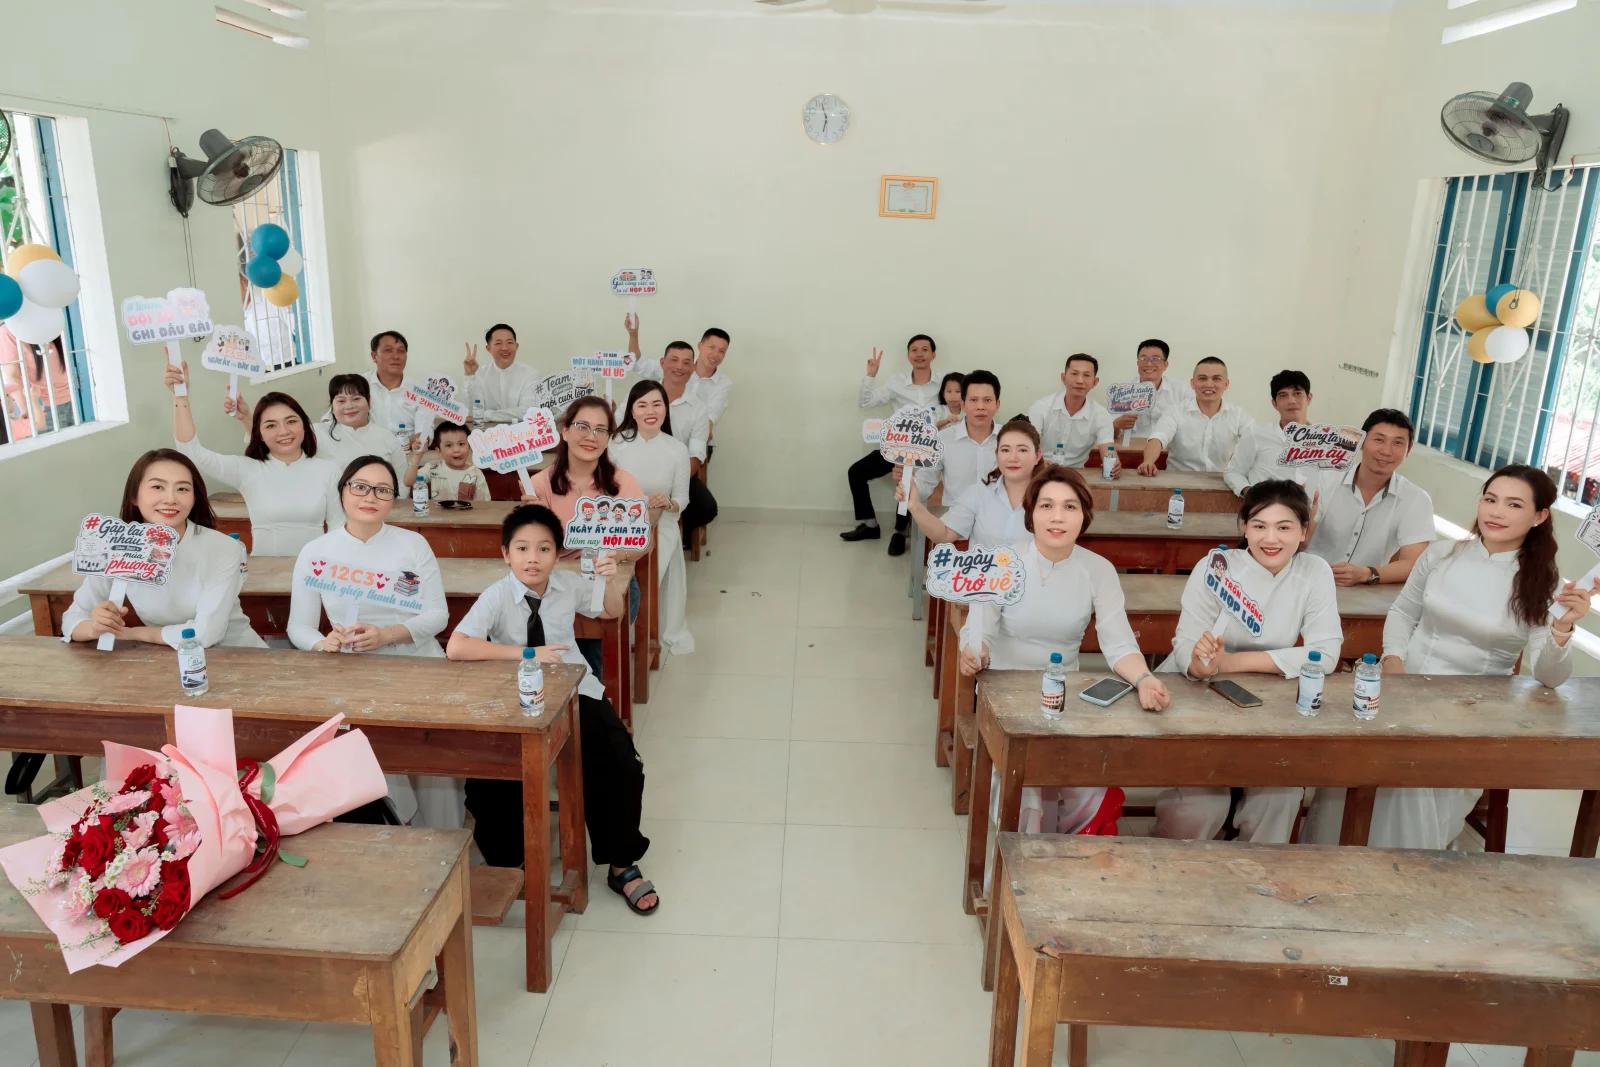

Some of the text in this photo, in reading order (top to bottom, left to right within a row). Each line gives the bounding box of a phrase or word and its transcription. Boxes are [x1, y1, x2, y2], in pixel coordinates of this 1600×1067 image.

[127, 311, 153, 328] ĐỘI
[132, 320, 211, 341] GHI ĐẦU BÀI
[572, 358, 623, 367] MỘT HÀNH TRÌNH
[613, 367, 625, 377] ỨC
[558, 391, 574, 405] cuối
[574, 388, 586, 399] lớp
[404, 390, 463, 423] NK 2003-2006
[896, 419, 924, 435] Hội
[886, 429, 910, 443] bạn
[911, 432, 940, 452] thân
[1302, 439, 1317, 447] của
[1327, 432, 1338, 443] ta
[479, 434, 555, 465] Nơi Thanh Xuân
[1325, 446, 1348, 465] ấy
[499, 450, 539, 471] còn mãi
[127, 524, 146, 537] lại
[570, 523, 647, 534] NGÀY ẤY CHIA TAY
[109, 532, 145, 546] nhau
[568, 536, 585, 546] Hôm
[603, 534, 622, 548] HỘI
[624, 535, 646, 548] NGỘ
[123, 551, 145, 560] mùa
[105, 558, 157, 579] phượng
[330, 564, 376, 587] 12C3
[952, 569, 1014, 593] trở về
[1224, 577, 1242, 600] TRỐN
[340, 584, 364, 600] ghép
[366, 589, 396, 605] thanh
[399, 600, 423, 611] xuân
[1206, 573, 1261, 634] ĐI HỌP LỚP
